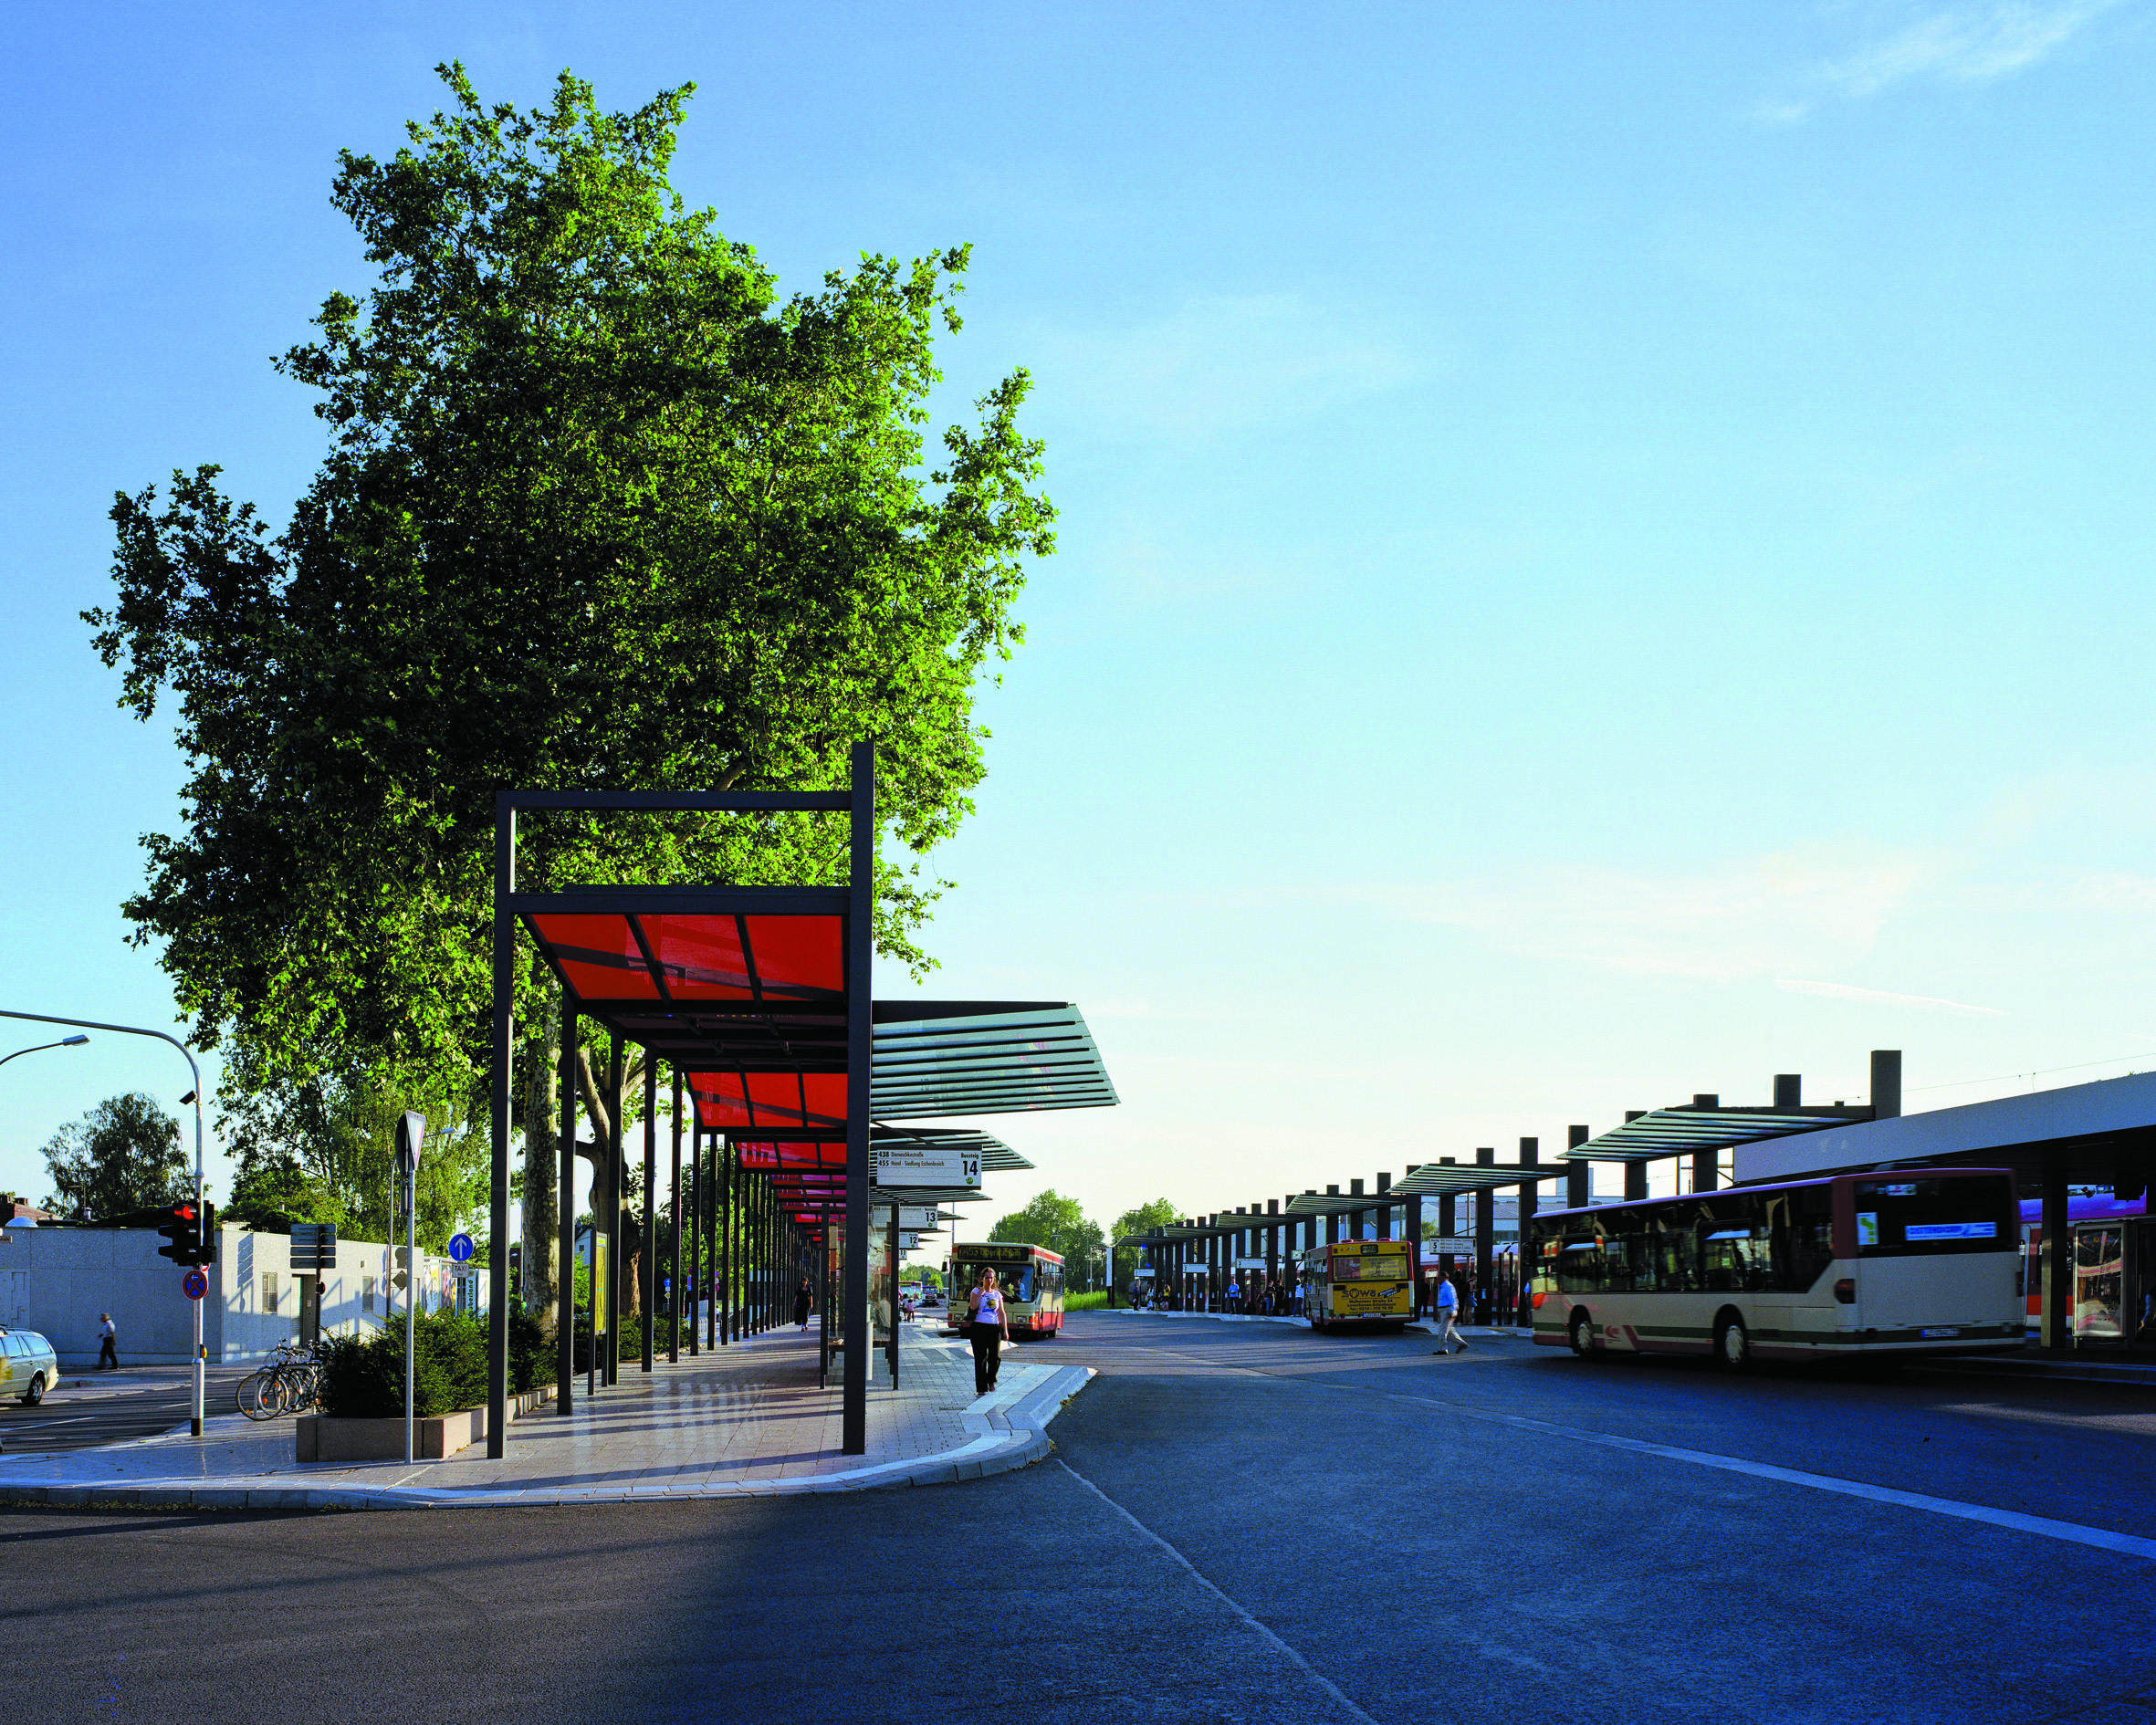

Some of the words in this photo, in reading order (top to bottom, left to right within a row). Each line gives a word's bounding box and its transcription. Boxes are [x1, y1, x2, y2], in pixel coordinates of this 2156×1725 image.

[960, 1152, 979, 1160] Bussteig
[962, 1160, 979, 1176] 14
[926, 1212, 936, 1222] 13
[909, 1236, 917, 1244] 12
[1432, 1241, 1438, 1249] 5
